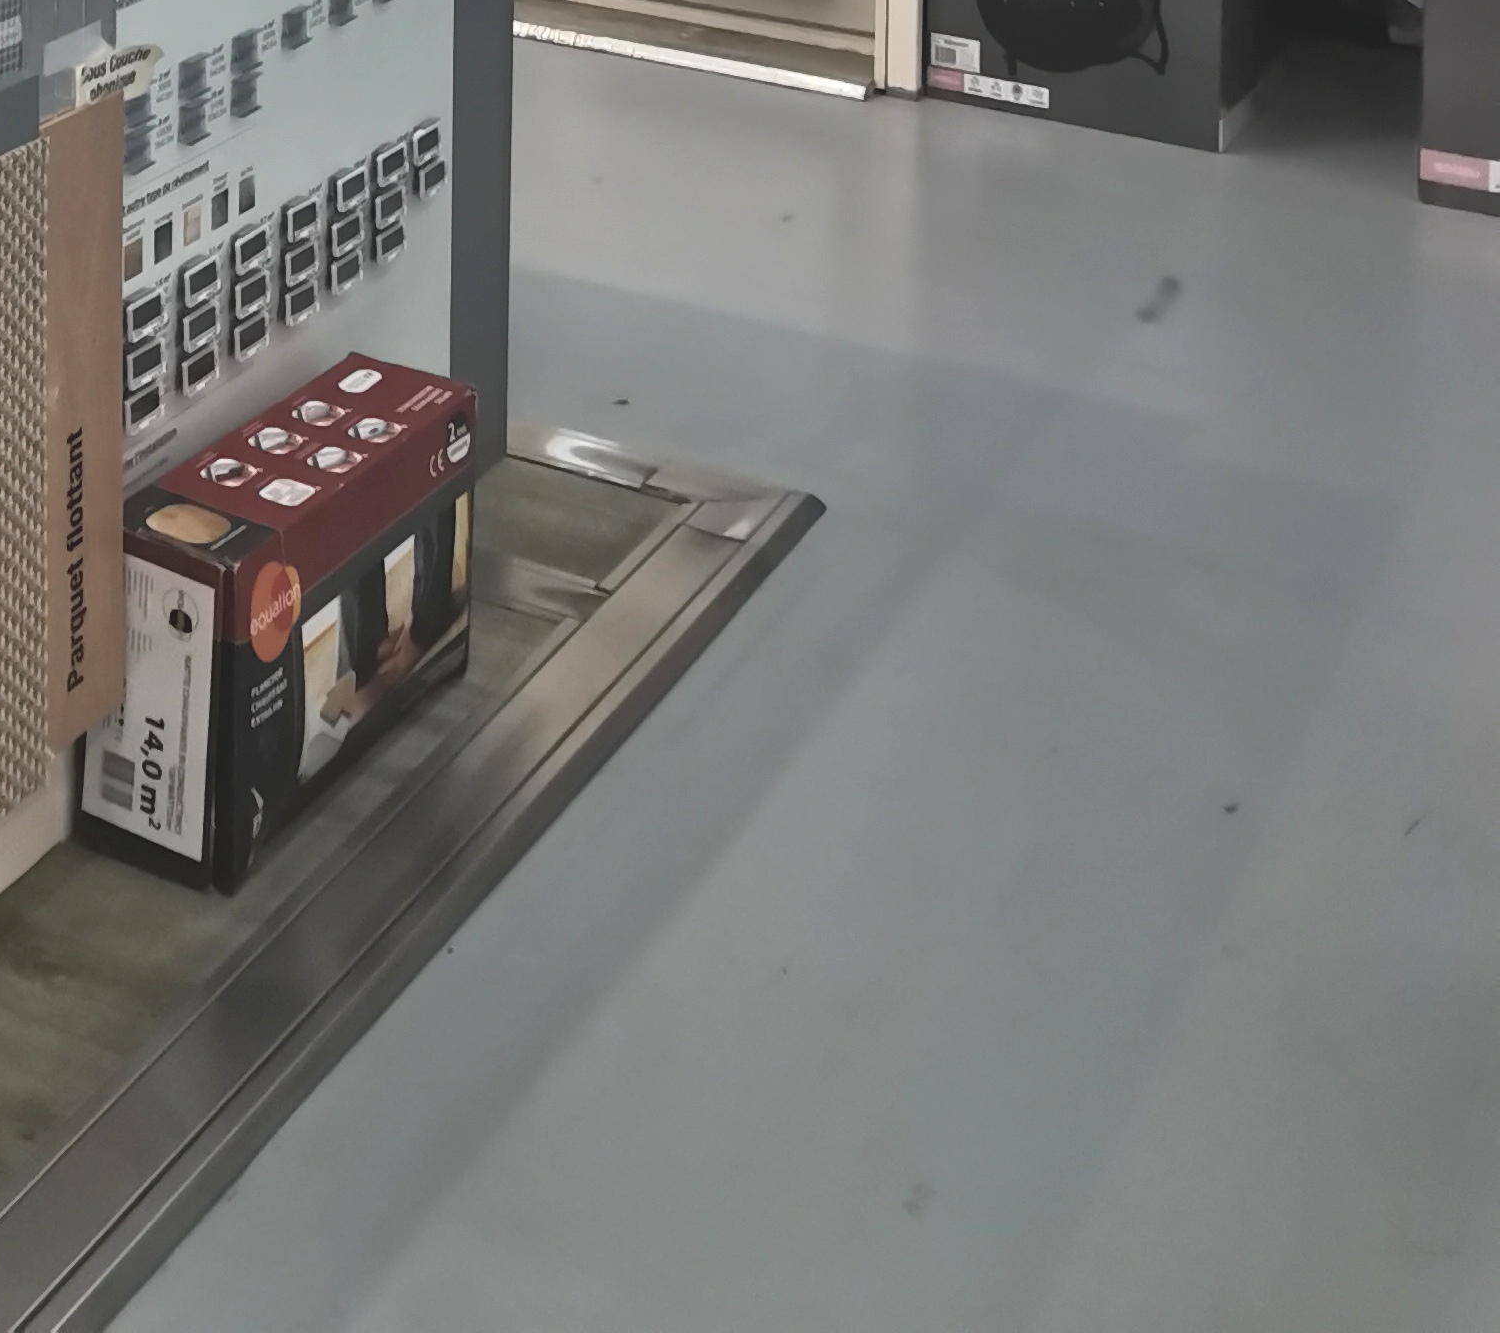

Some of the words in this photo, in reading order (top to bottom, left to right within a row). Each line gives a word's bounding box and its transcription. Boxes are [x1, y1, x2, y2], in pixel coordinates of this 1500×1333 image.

[65, 425, 84, 553] flottant
[66, 555, 88, 694] Parquet
[249, 581, 301, 638] equation
[138, 714, 165, 782] 14,0
